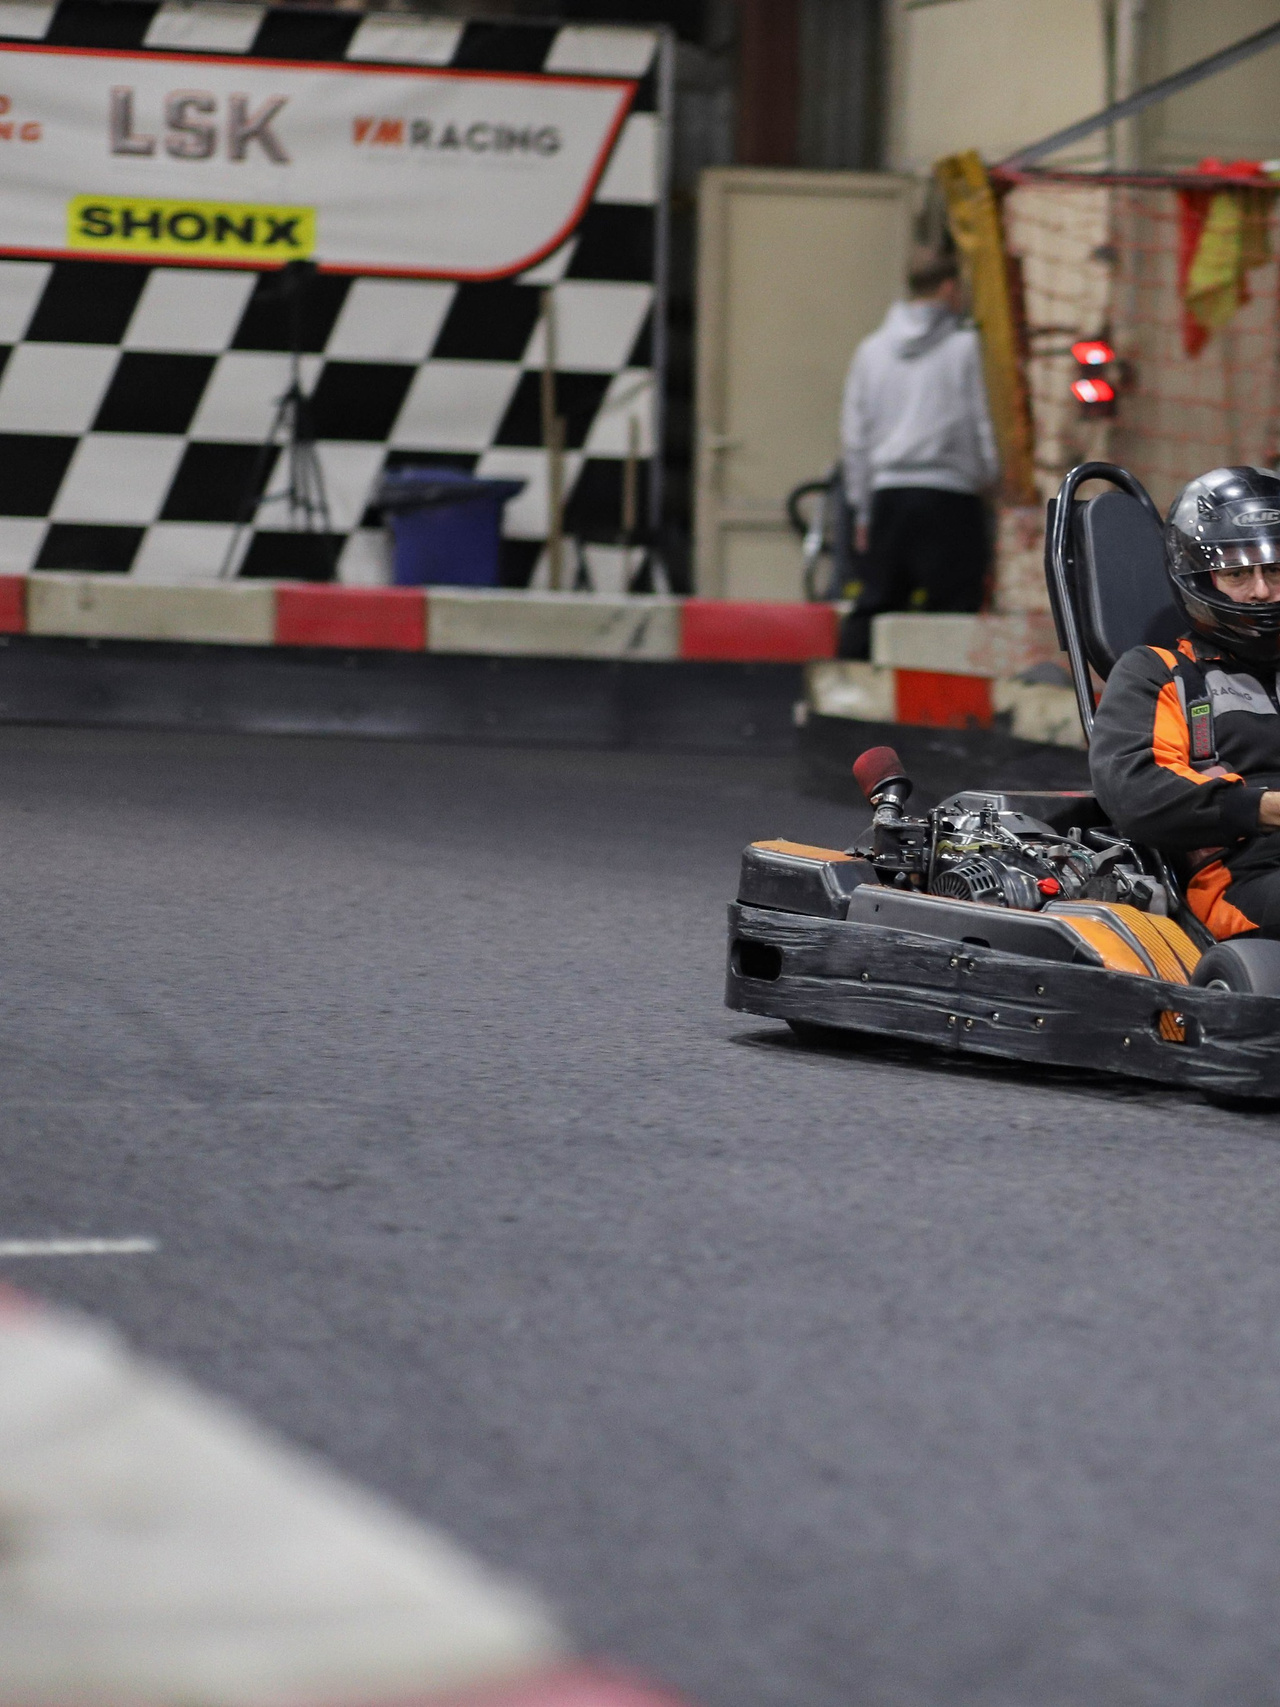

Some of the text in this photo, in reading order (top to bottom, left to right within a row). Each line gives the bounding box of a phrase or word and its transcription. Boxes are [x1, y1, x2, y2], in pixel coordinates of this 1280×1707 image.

[110, 84, 291, 165] LSK
[409, 119, 562, 157] RACING
[80, 206, 303, 247] SHONX
[1240, 511, 1280, 524] HJC
